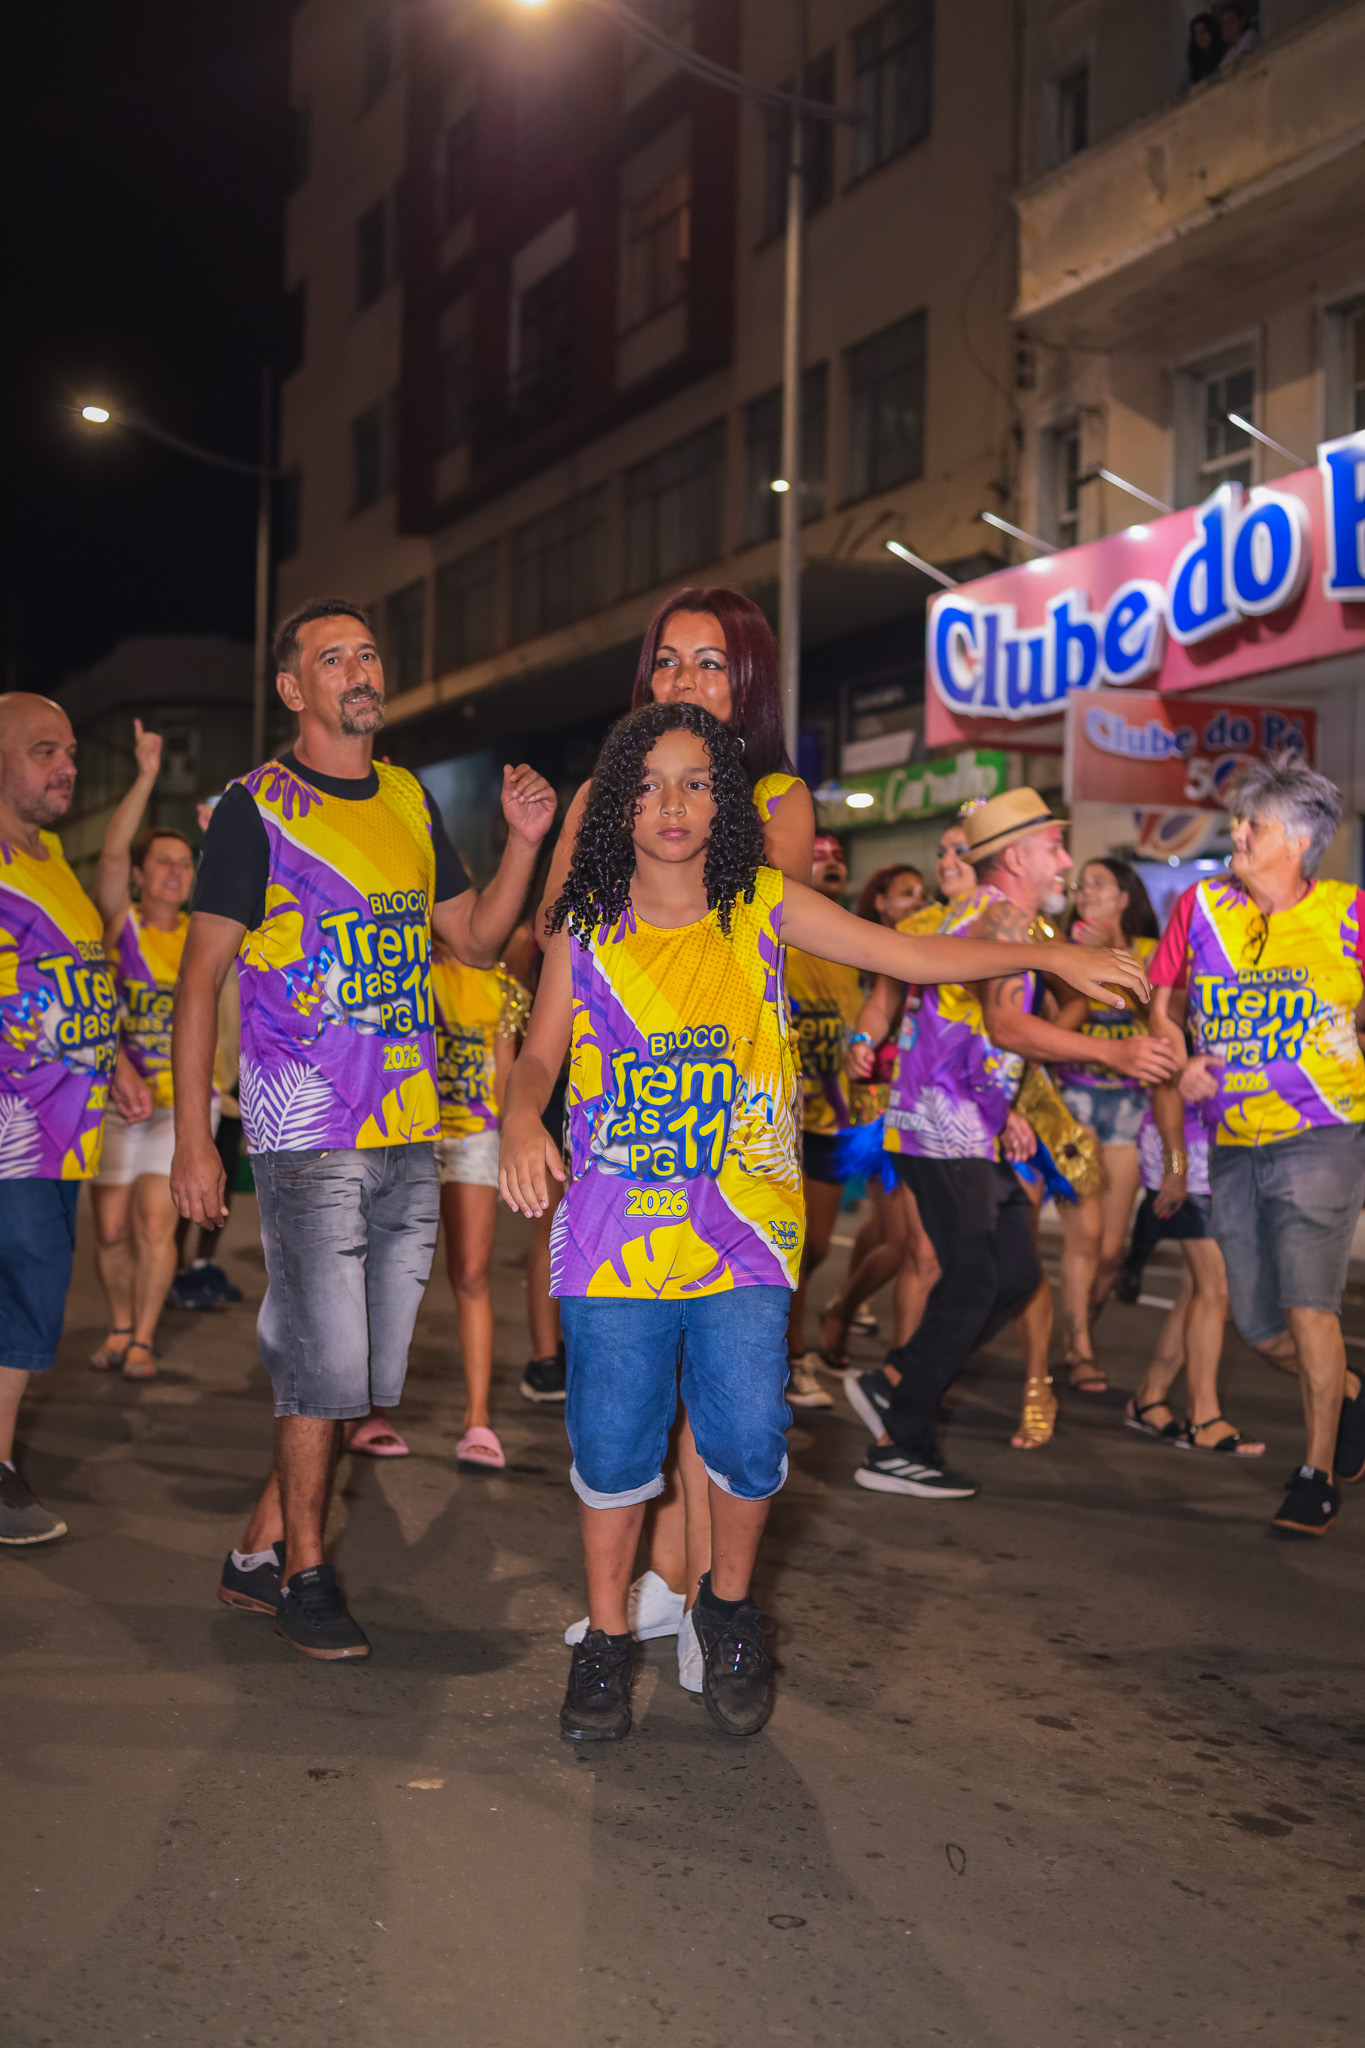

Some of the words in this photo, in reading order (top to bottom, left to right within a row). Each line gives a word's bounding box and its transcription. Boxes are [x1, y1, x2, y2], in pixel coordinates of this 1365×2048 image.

[932, 580, 1160, 718] Clube
[1168, 482, 1306, 645] do
[1085, 707, 1194, 759] Clube
[1204, 711, 1254, 749] do
[369, 891, 427, 915] BLOCO
[37, 954, 118, 1010] Tre
[123, 979, 173, 1019] Tre
[341, 969, 398, 1005] das
[1194, 975, 1314, 1019] Trem
[59, 1012, 111, 1044] das
[380, 1003, 413, 1032] PG
[649, 1026, 727, 1057] BLOCO
[1203, 1017, 1253, 1040] das
[1256, 1016, 1304, 1059] 11
[1226, 1042, 1261, 1066] PG
[382, 1041, 422, 1072] 2026
[611, 1050, 734, 1107] Trem
[1222, 1070, 1269, 1093] 2026
[609, 1107, 661, 1138] as
[666, 1103, 726, 1172] 11
[629, 1143, 676, 1177] PG
[625, 1187, 689, 1218] 2026
